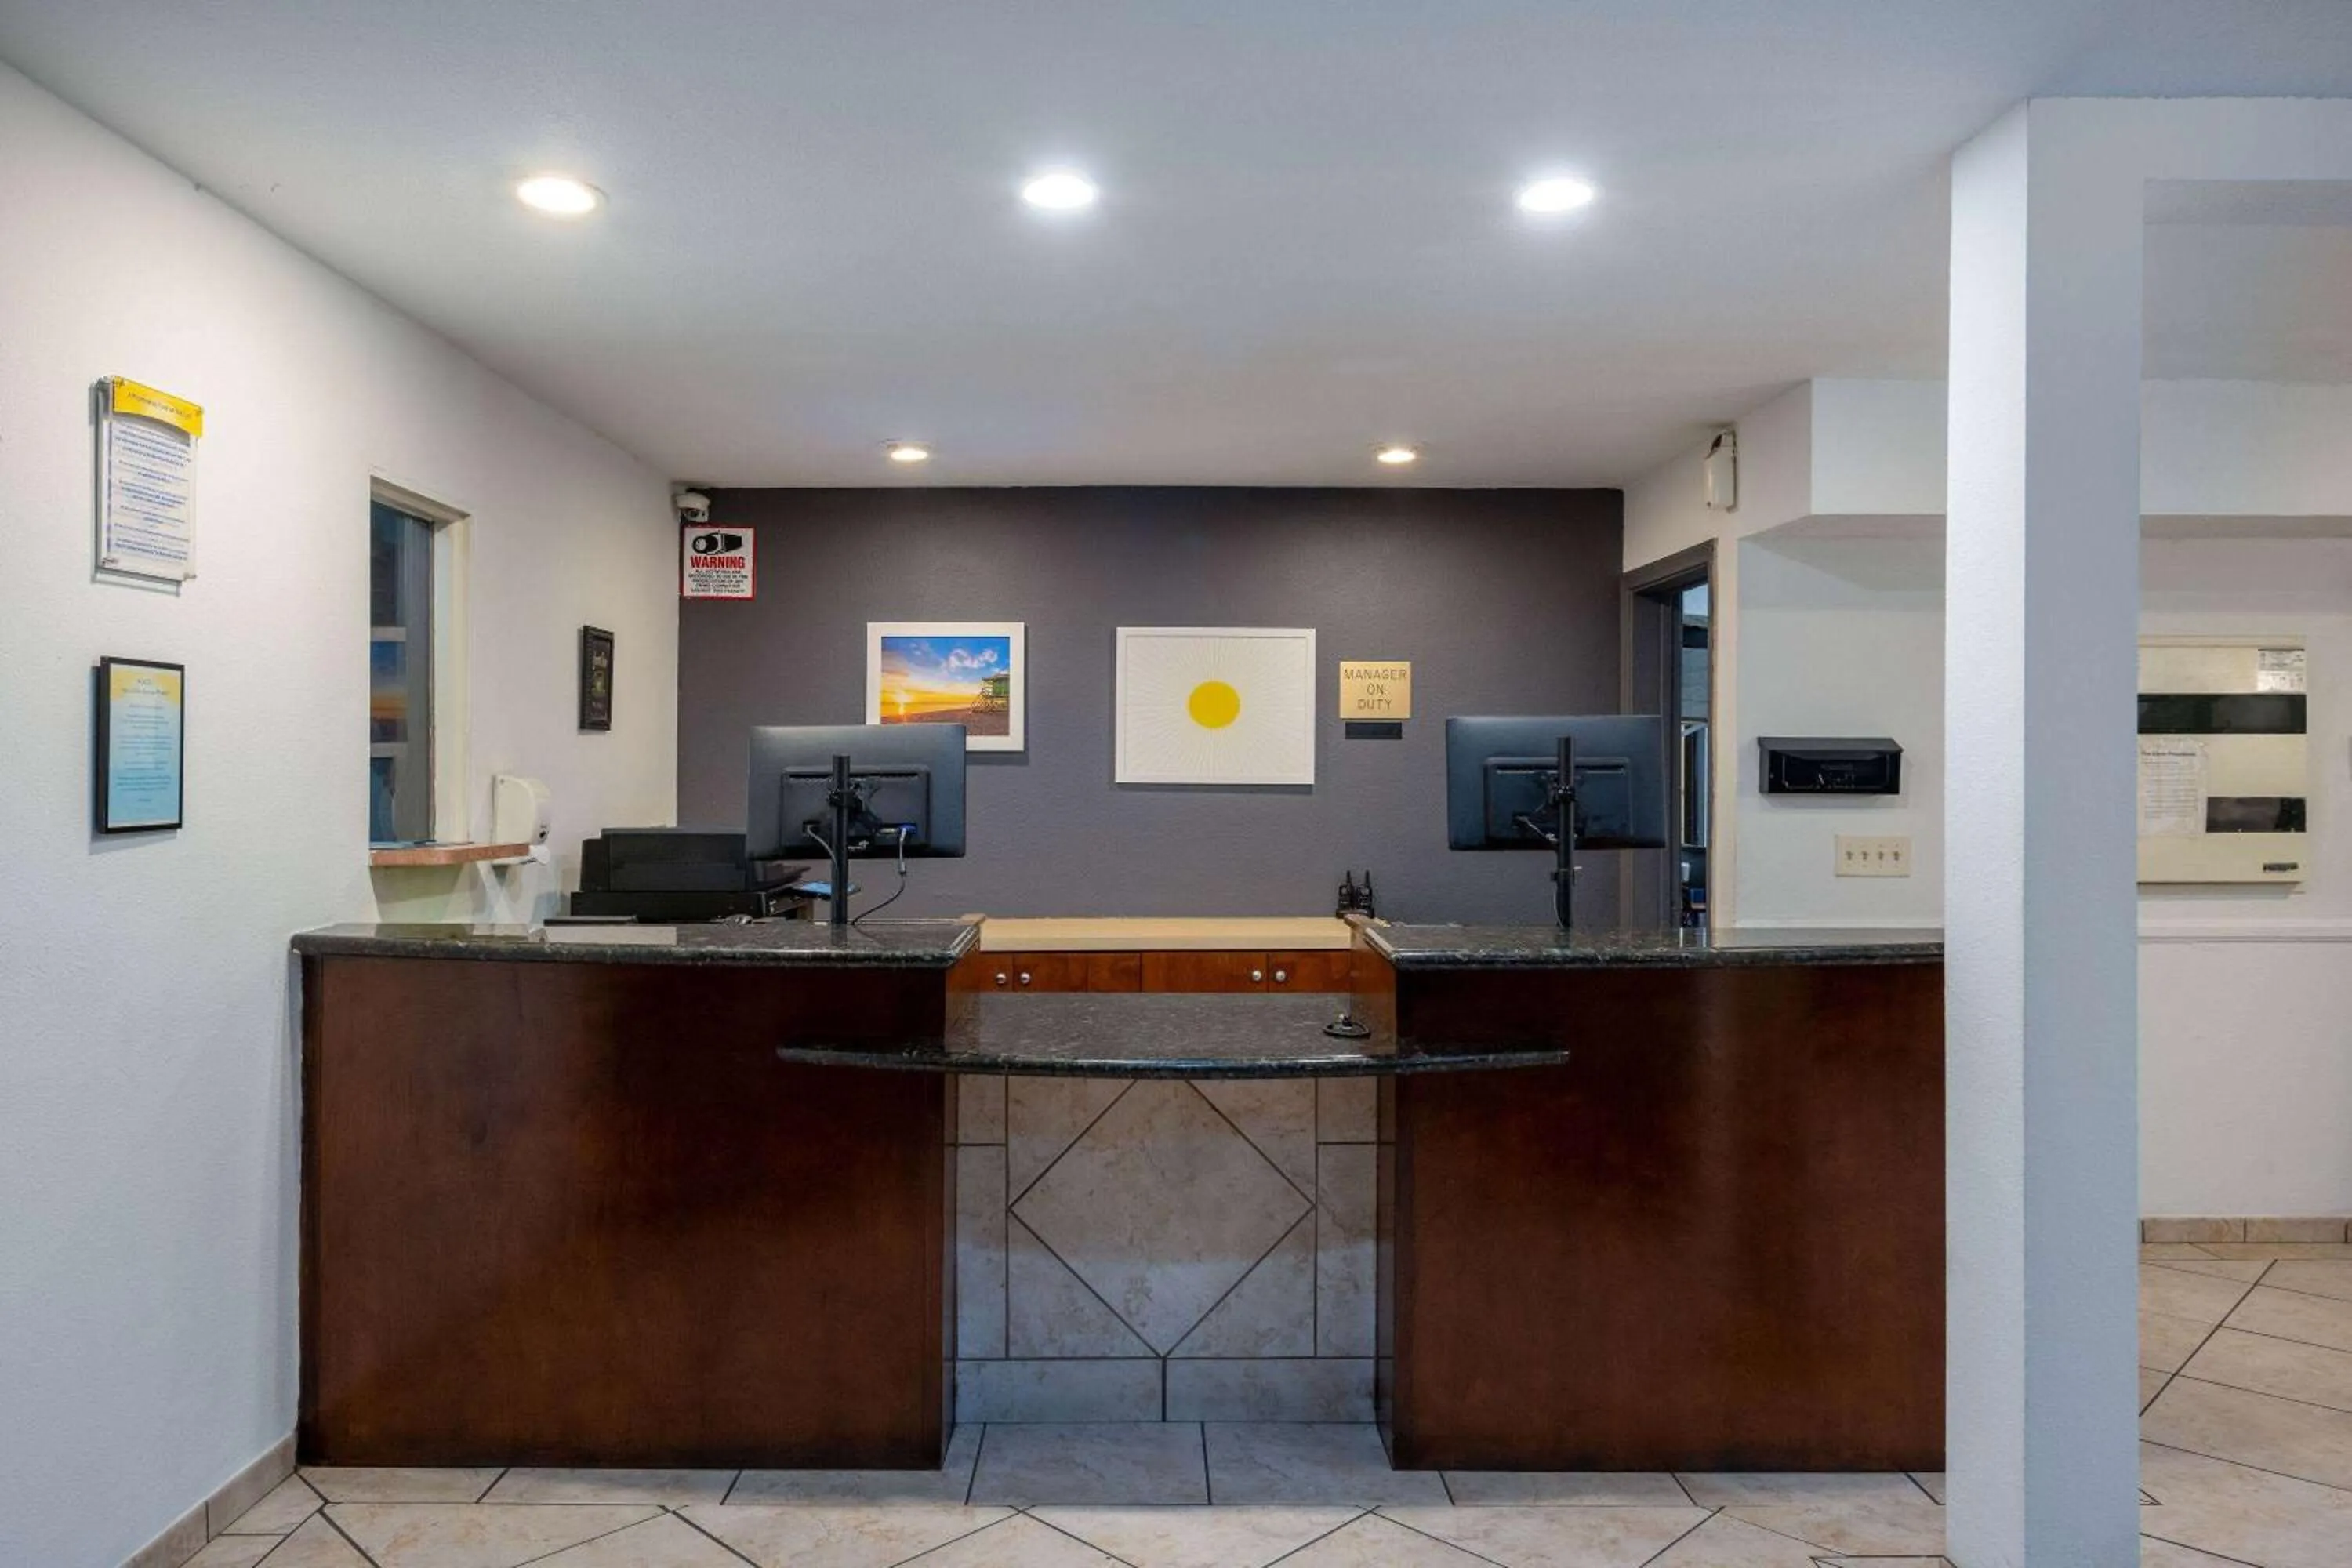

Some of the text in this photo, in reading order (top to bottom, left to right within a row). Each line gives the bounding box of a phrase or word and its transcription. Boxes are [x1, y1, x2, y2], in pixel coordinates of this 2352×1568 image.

[690, 556, 746, 568] WARNING
[1344, 669, 1407, 680] MANAGER
[1367, 683, 1385, 695] ON
[1357, 699, 1392, 710] DUTY
